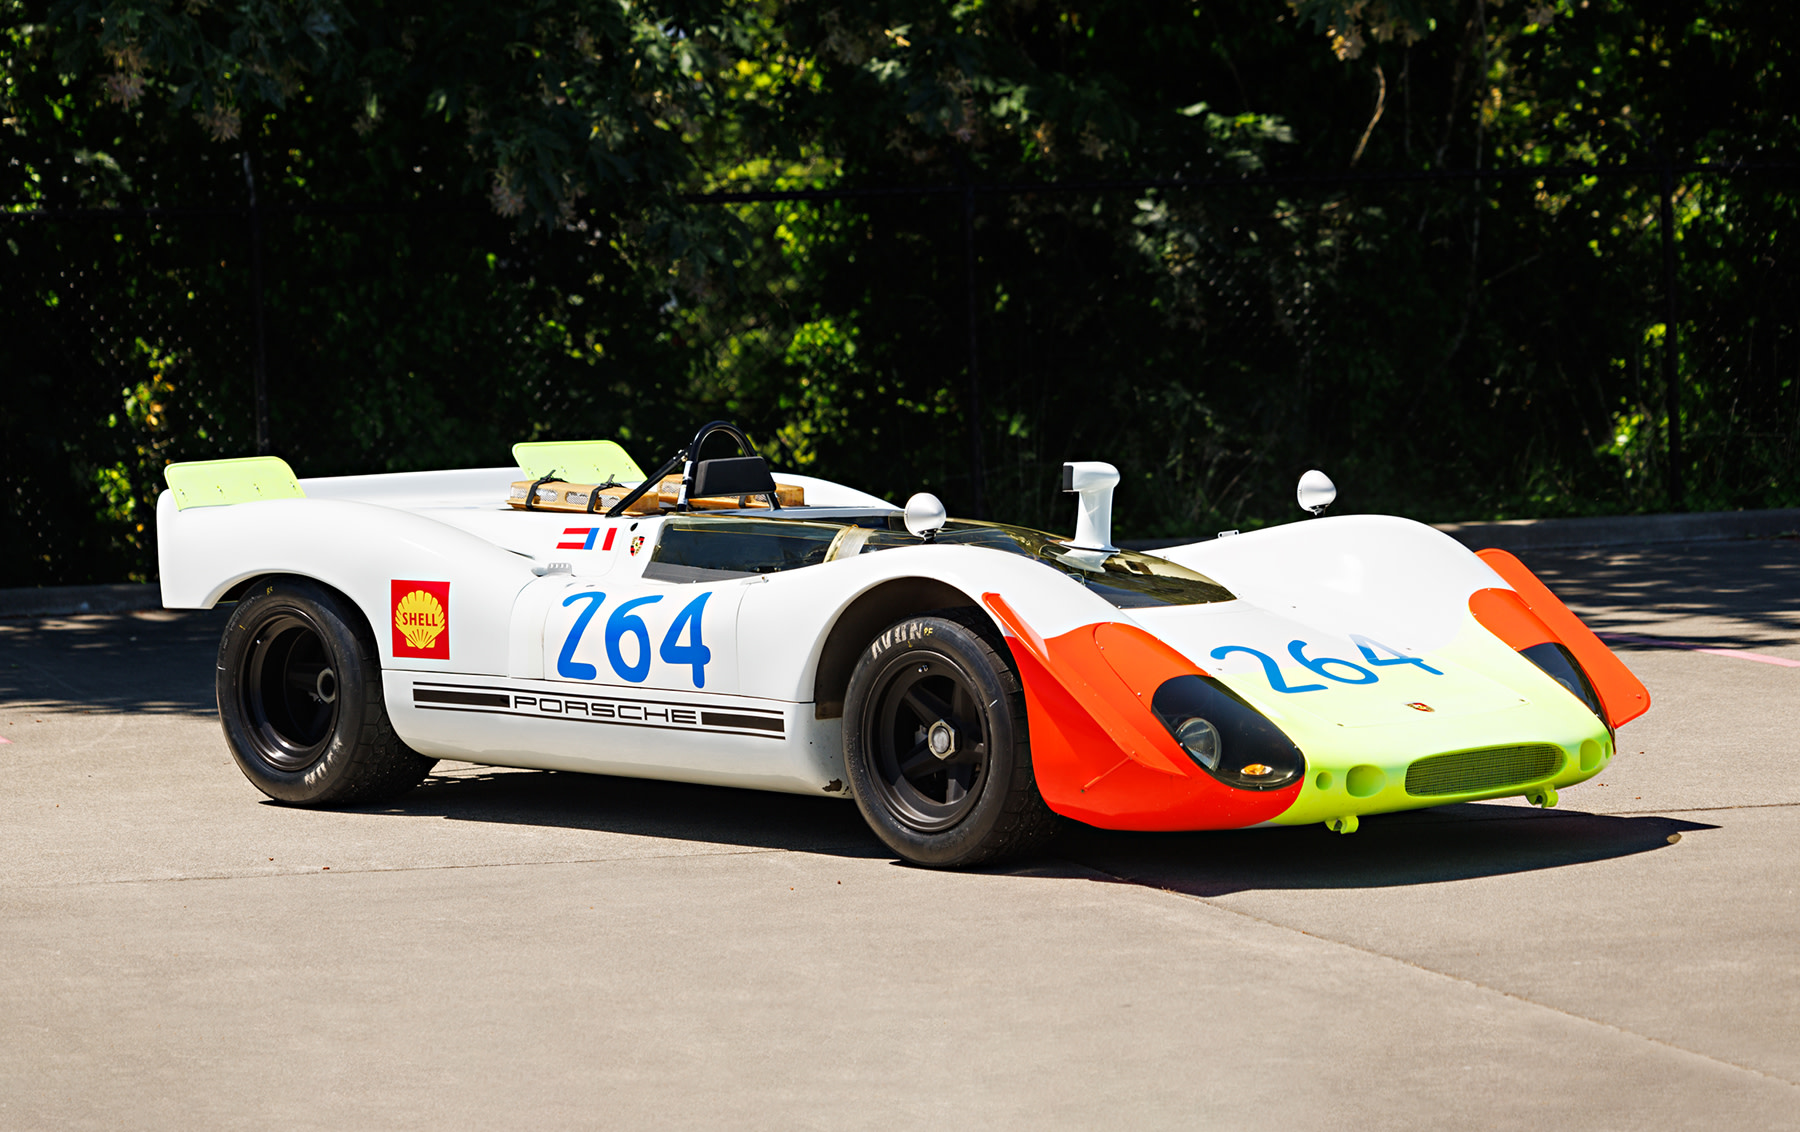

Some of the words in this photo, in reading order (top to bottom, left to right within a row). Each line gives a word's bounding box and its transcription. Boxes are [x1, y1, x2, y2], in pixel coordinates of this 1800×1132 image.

[402, 612, 438, 627] SHELL
[557, 591, 713, 689] 264
[1210, 633, 1445, 694] 264
[513, 694, 697, 725] PORSCHE
